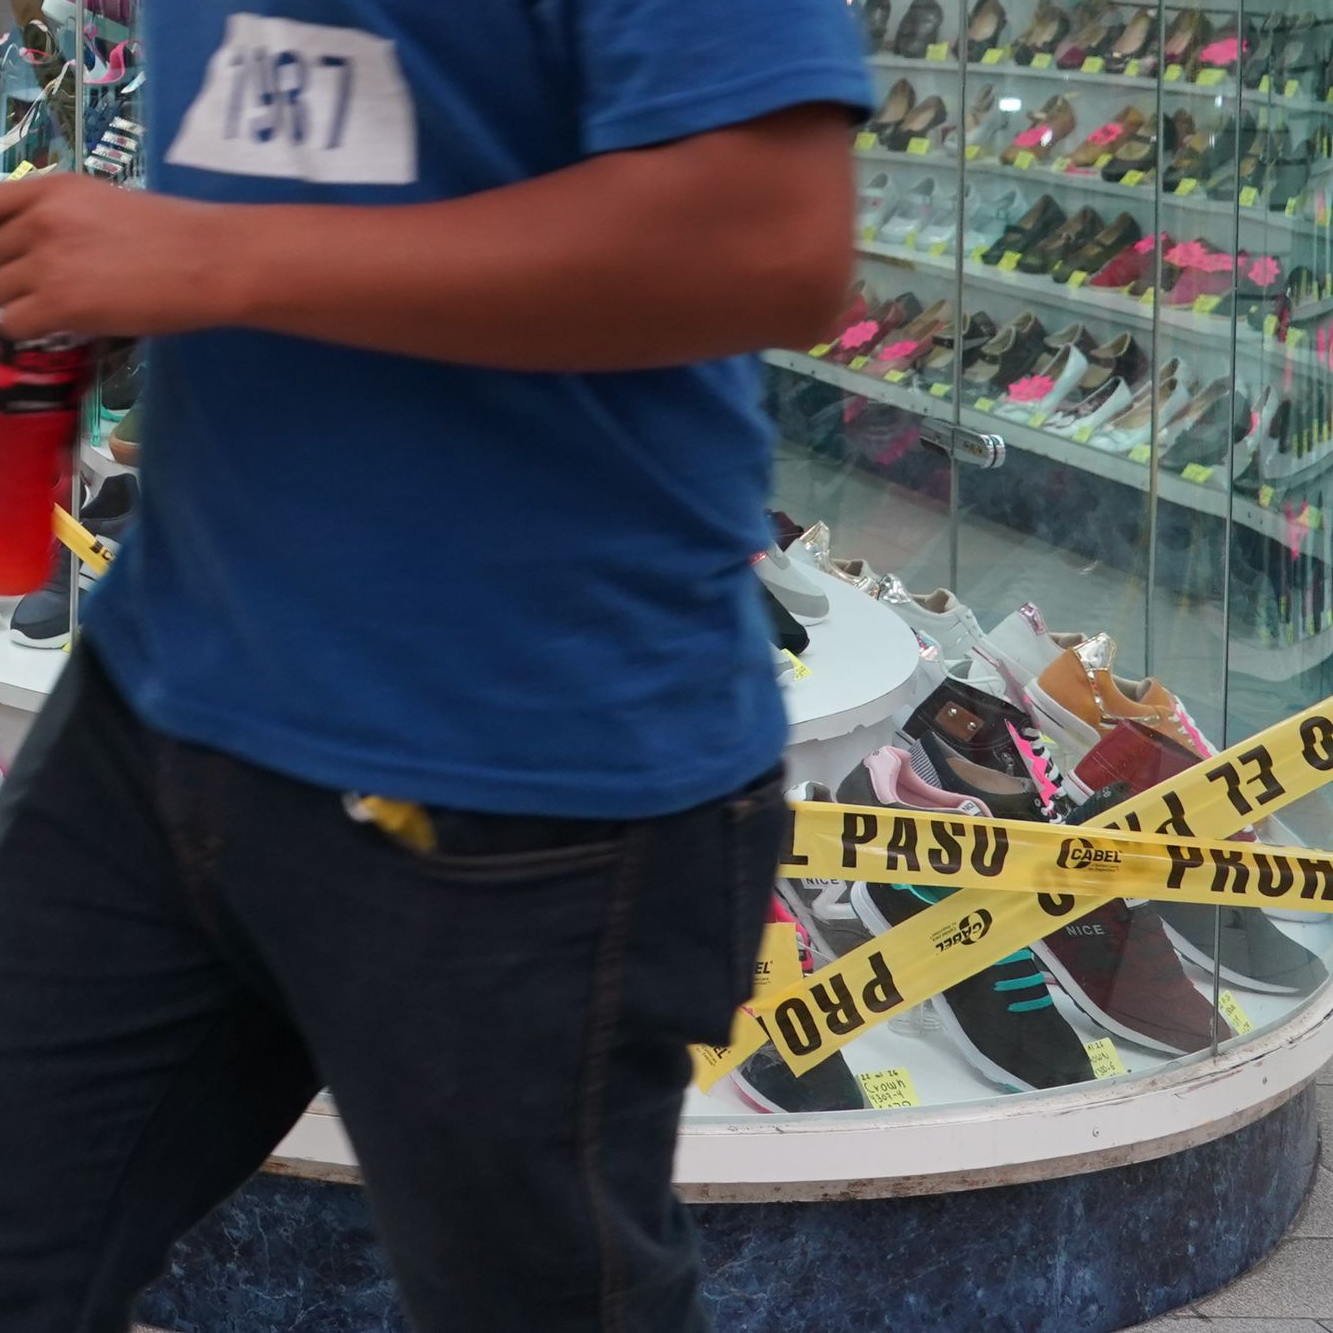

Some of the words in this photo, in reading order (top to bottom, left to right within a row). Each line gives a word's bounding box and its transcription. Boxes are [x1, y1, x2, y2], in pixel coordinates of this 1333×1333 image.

[841, 812, 1010, 877] PASO
[1070, 848, 1122, 863] CABEL
[1066, 924, 1106, 937] NICE
[775, 951, 904, 1056] PRO
